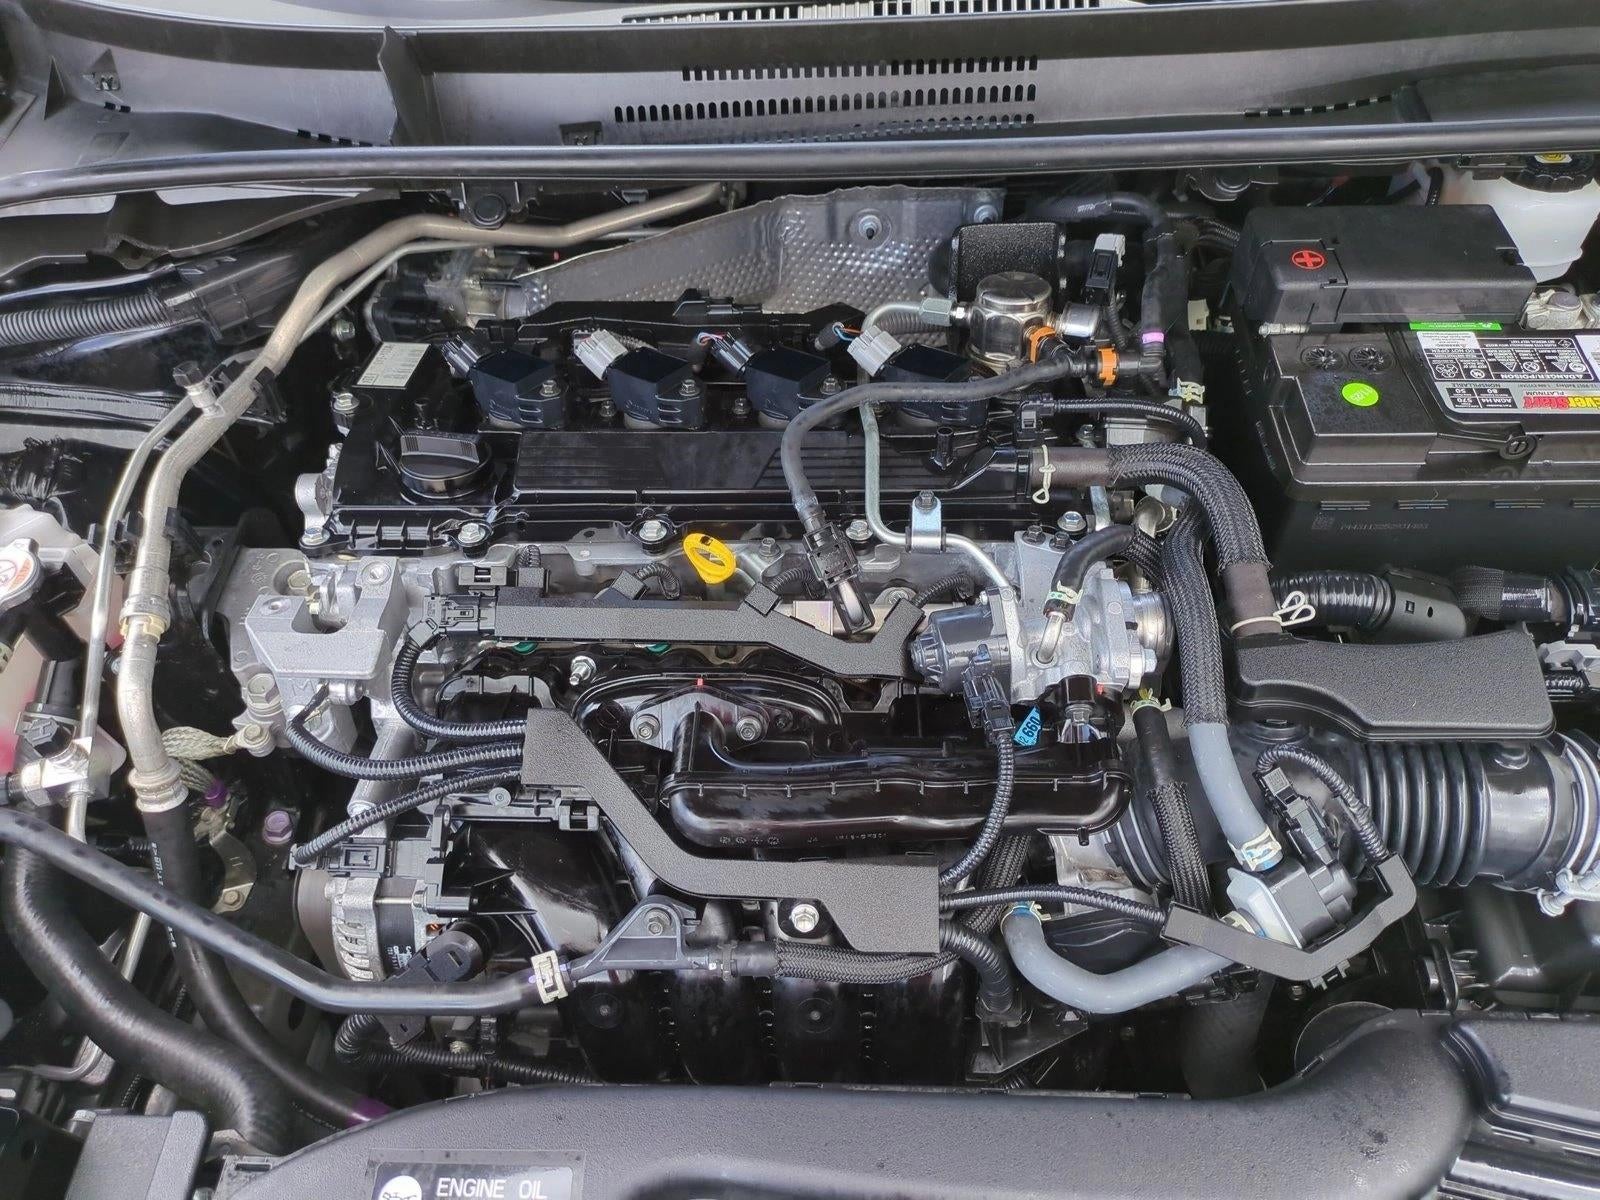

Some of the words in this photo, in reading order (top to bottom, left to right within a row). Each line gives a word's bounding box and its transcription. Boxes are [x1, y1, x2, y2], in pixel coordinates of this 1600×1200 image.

[1022, 716, 1041, 738] 660
[436, 1177, 507, 1198] ENGINE
[518, 1180, 548, 1200] OIL
